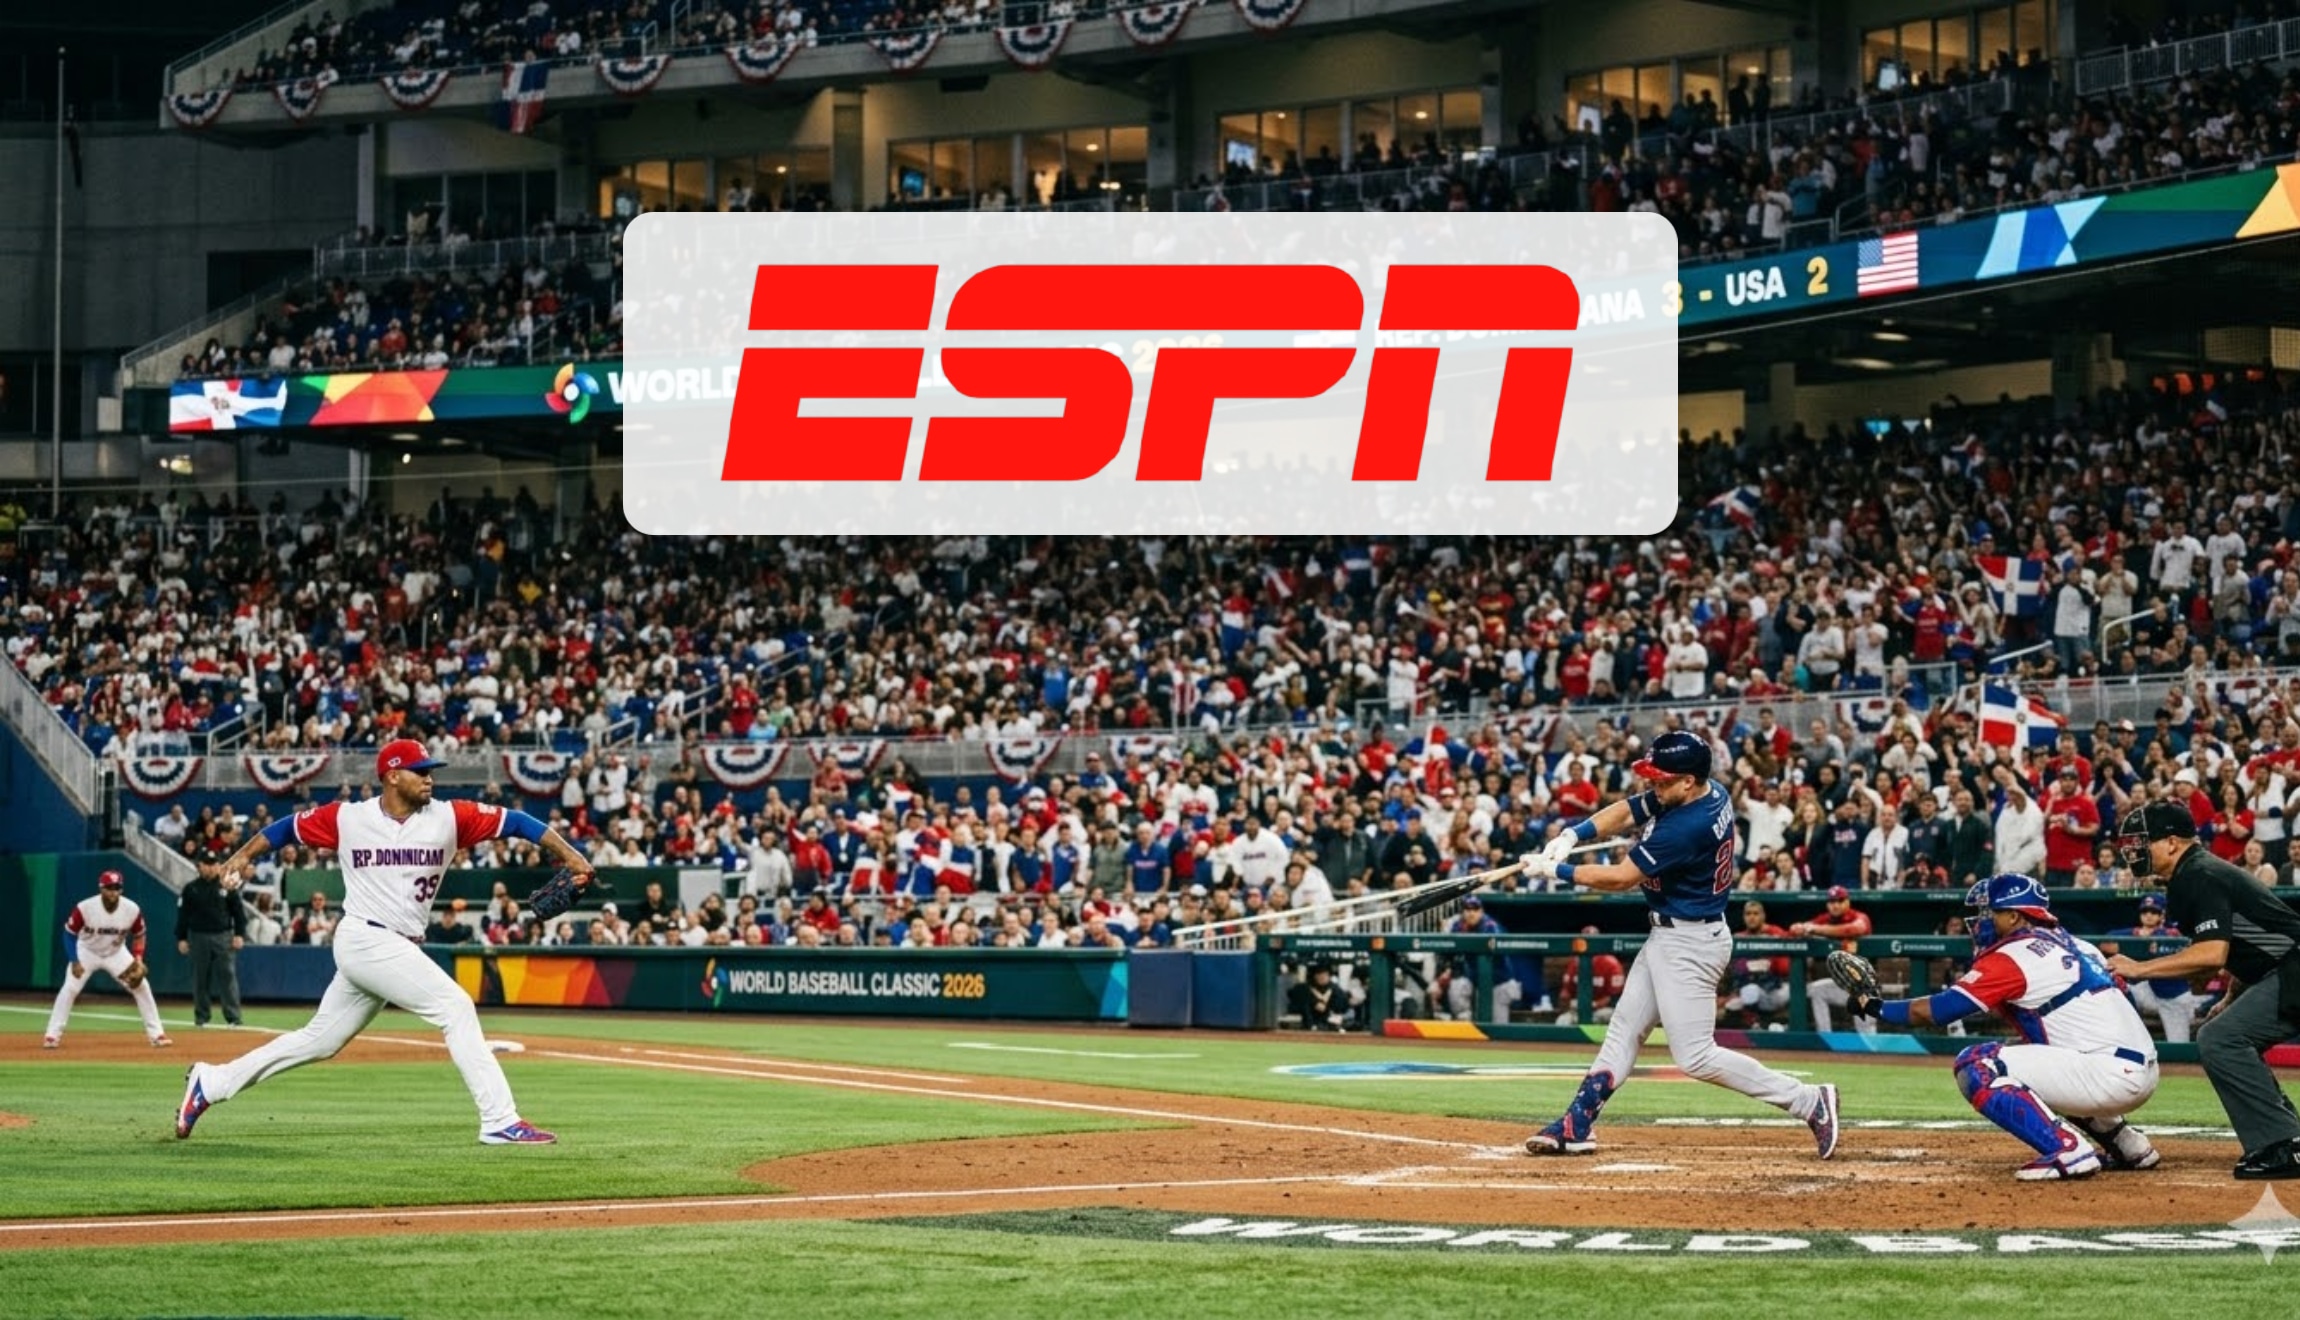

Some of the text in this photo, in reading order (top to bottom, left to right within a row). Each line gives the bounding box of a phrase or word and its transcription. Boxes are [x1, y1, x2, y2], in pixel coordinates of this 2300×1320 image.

[1661, 280, 1684, 318] 3
[1725, 265, 1788, 306] USA
[1807, 256, 1829, 296] 2
[729, 970, 985, 998] WORLD BASEBALL CLASSIC 2026
[1169, 1217, 1811, 1251] WORLD
